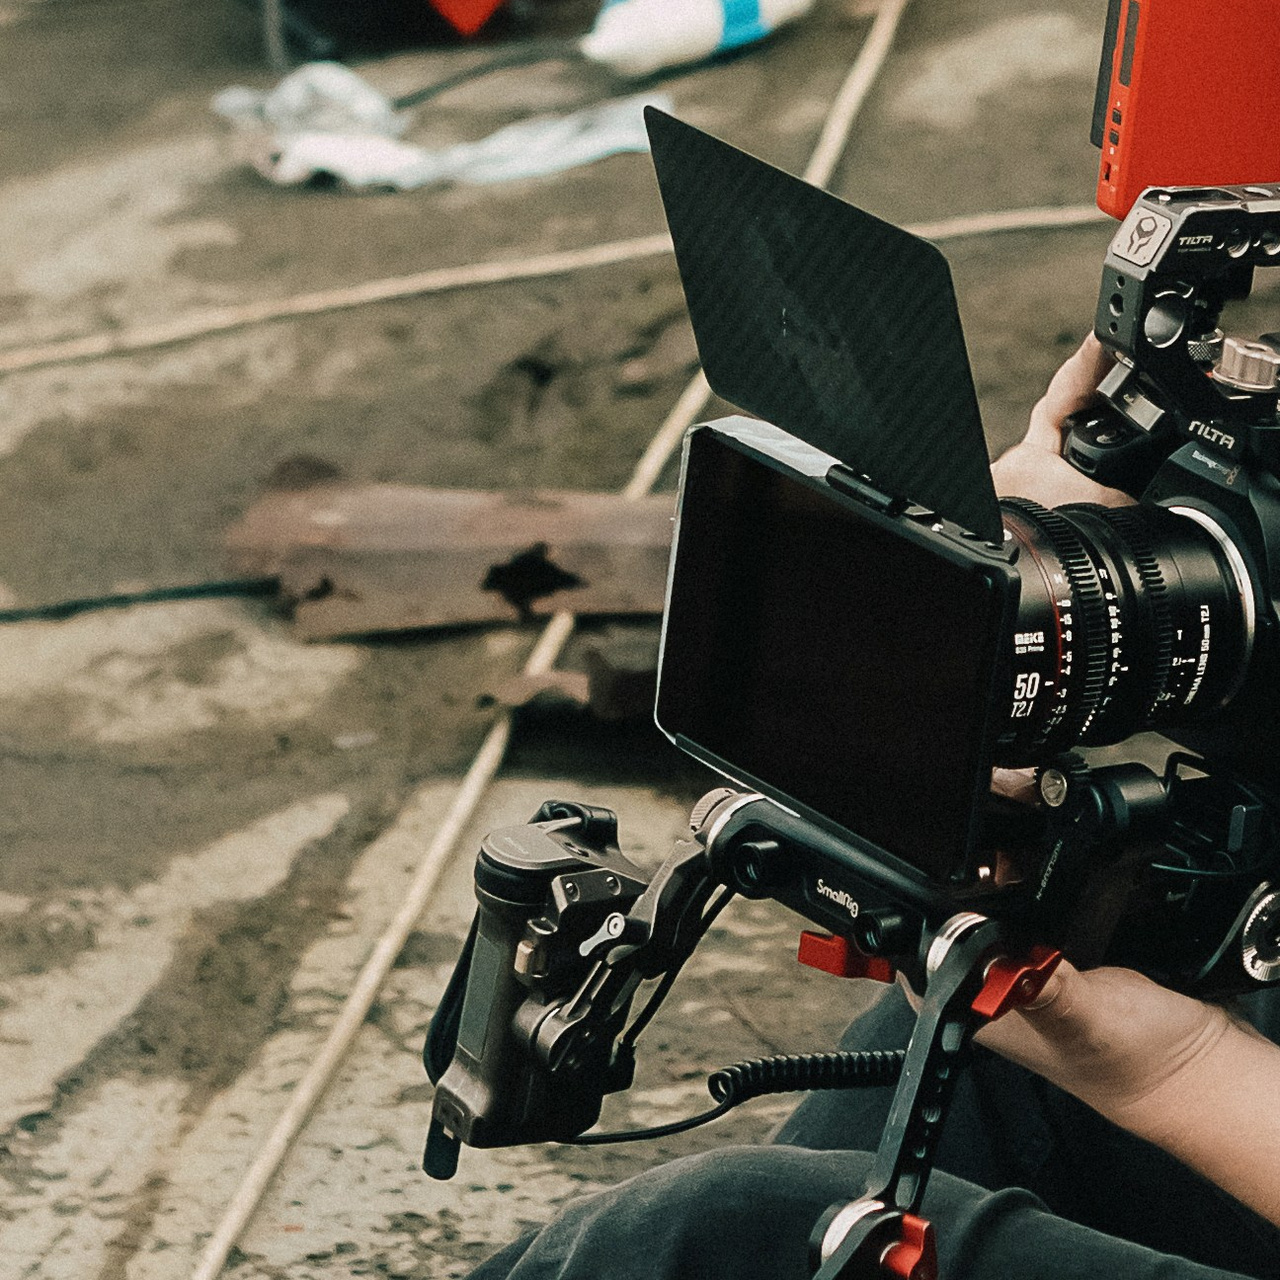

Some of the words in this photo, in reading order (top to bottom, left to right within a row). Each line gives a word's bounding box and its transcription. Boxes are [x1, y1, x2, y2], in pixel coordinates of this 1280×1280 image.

[1178, 235, 1214, 246] TILTA
[1196, 653, 1209, 674] LENS
[1013, 672, 1040, 700] 50
[1010, 701, 1034, 718] T2.1
[816, 878, 859, 919] SmallRig
